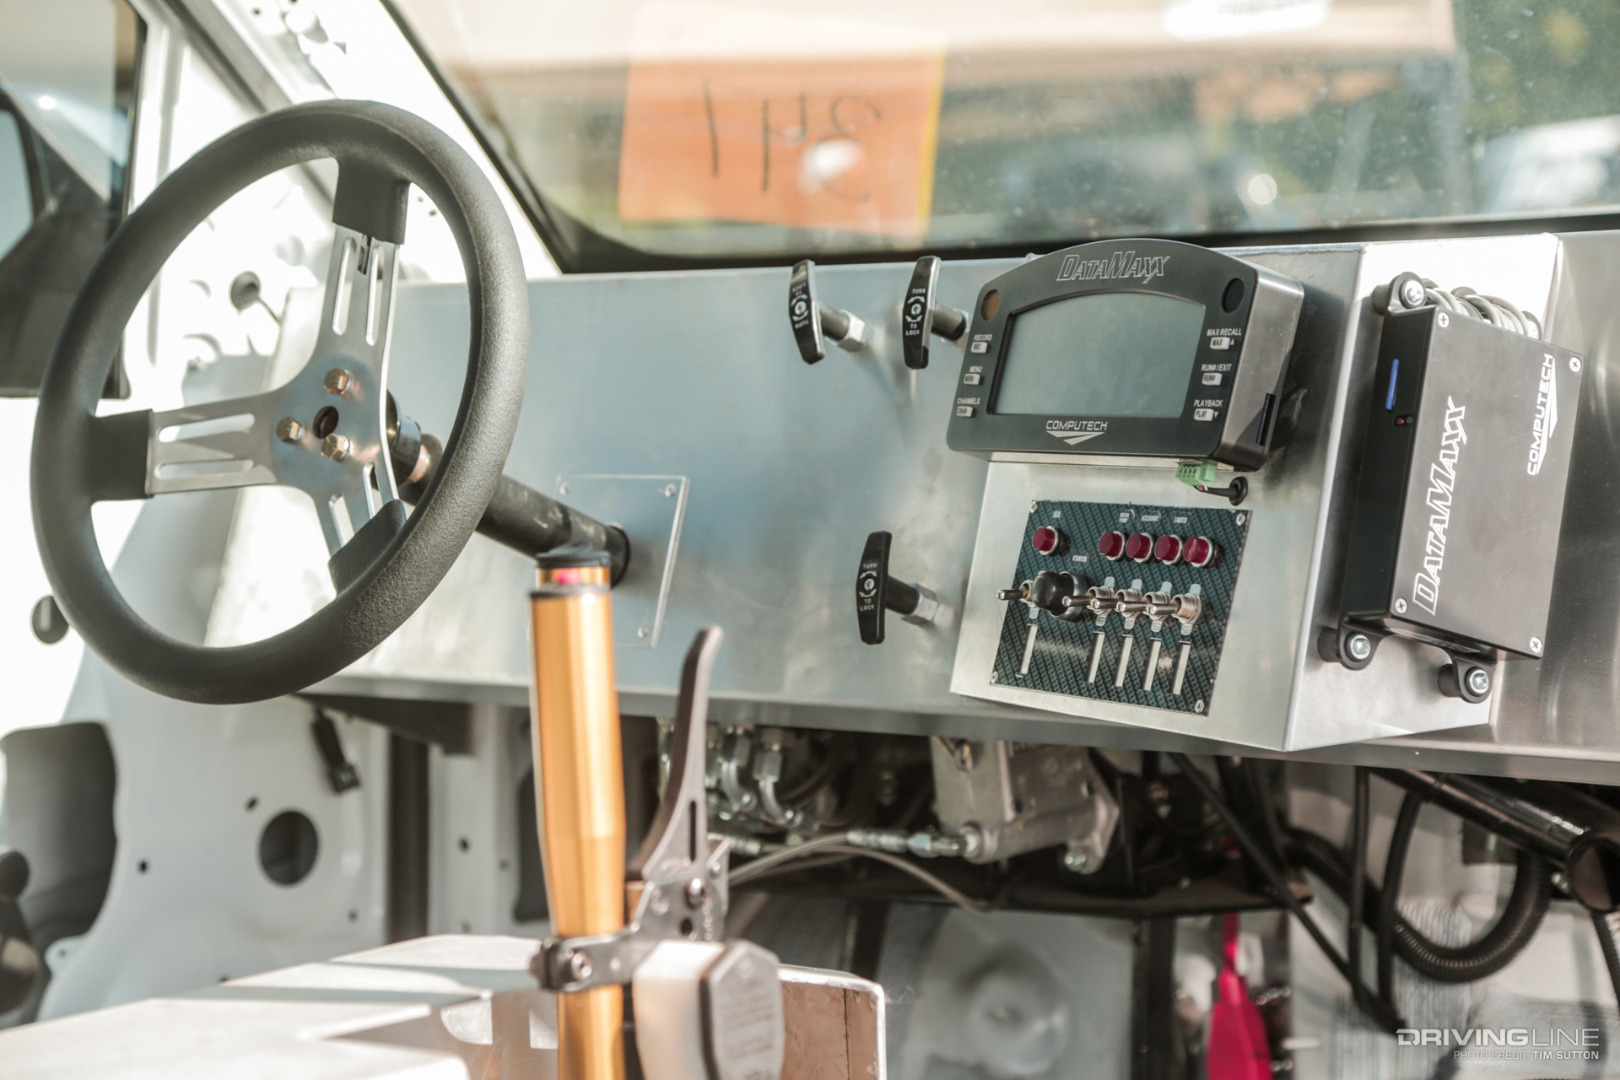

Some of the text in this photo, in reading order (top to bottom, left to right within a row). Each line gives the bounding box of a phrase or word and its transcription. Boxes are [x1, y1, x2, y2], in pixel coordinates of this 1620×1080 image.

[1206, 328, 1242, 336] MAX RECALL
[957, 397, 981, 405] CHANNELS
[1193, 399, 1223, 407] PLAYBACK
[1526, 353, 1556, 476] COMPUTECH
[1045, 419, 1108, 432] COMPUTECH
